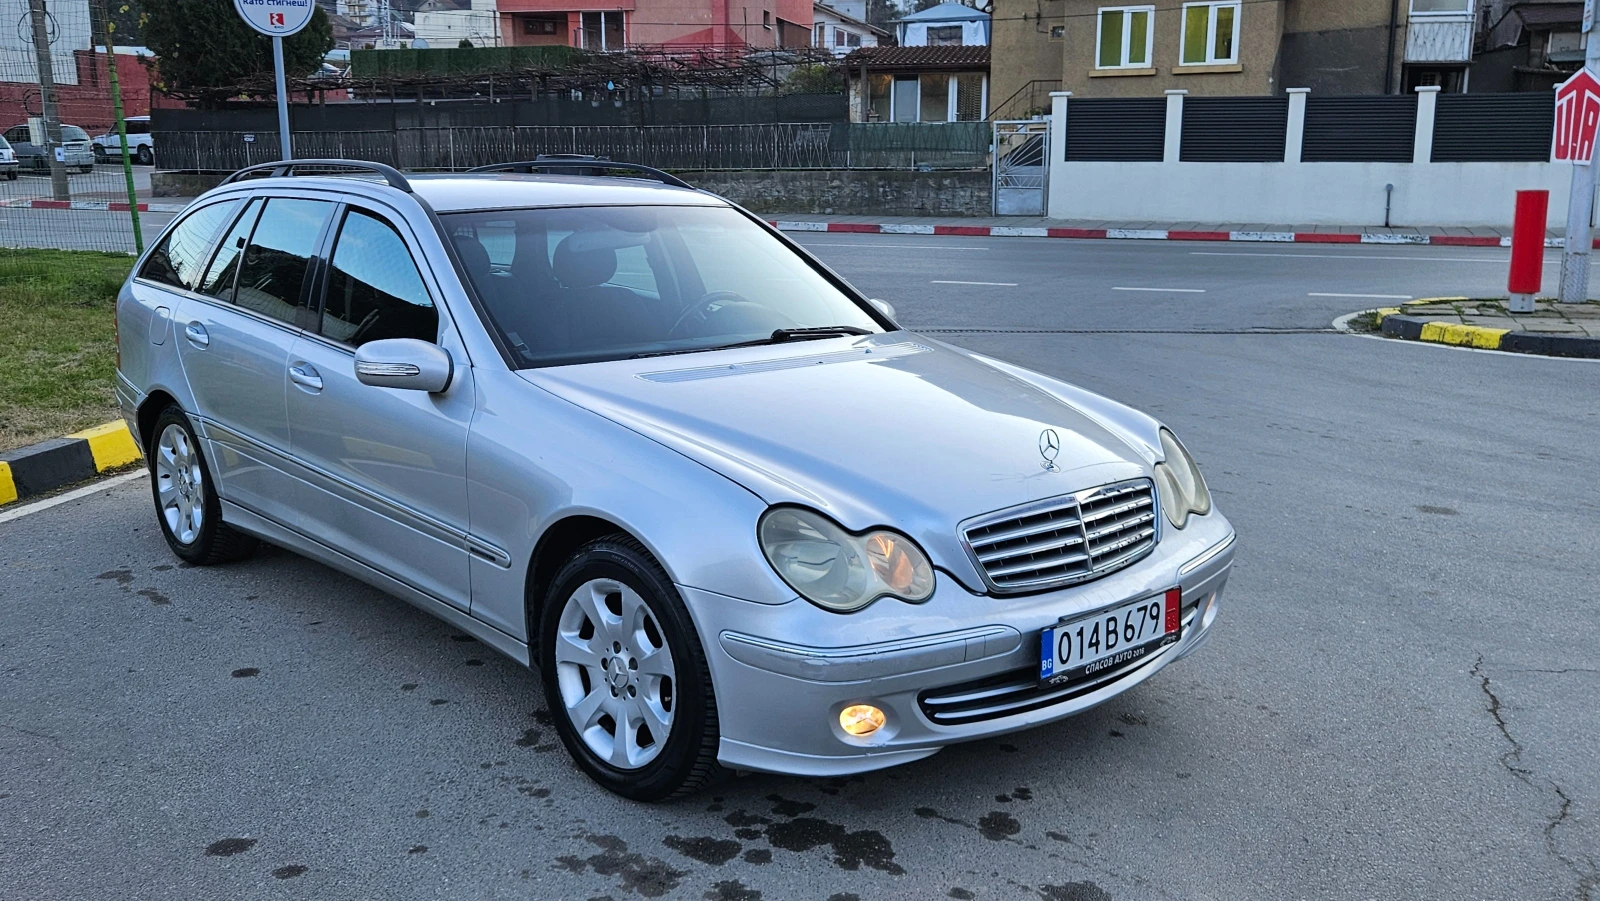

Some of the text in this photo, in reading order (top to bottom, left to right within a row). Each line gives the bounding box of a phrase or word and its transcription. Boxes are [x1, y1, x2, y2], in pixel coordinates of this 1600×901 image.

[1554, 71, 1600, 161] UTA
[1041, 658, 1053, 671] BG
[1085, 656, 1113, 675] СПАСОВ
[1114, 650, 1132, 665] АУТО
